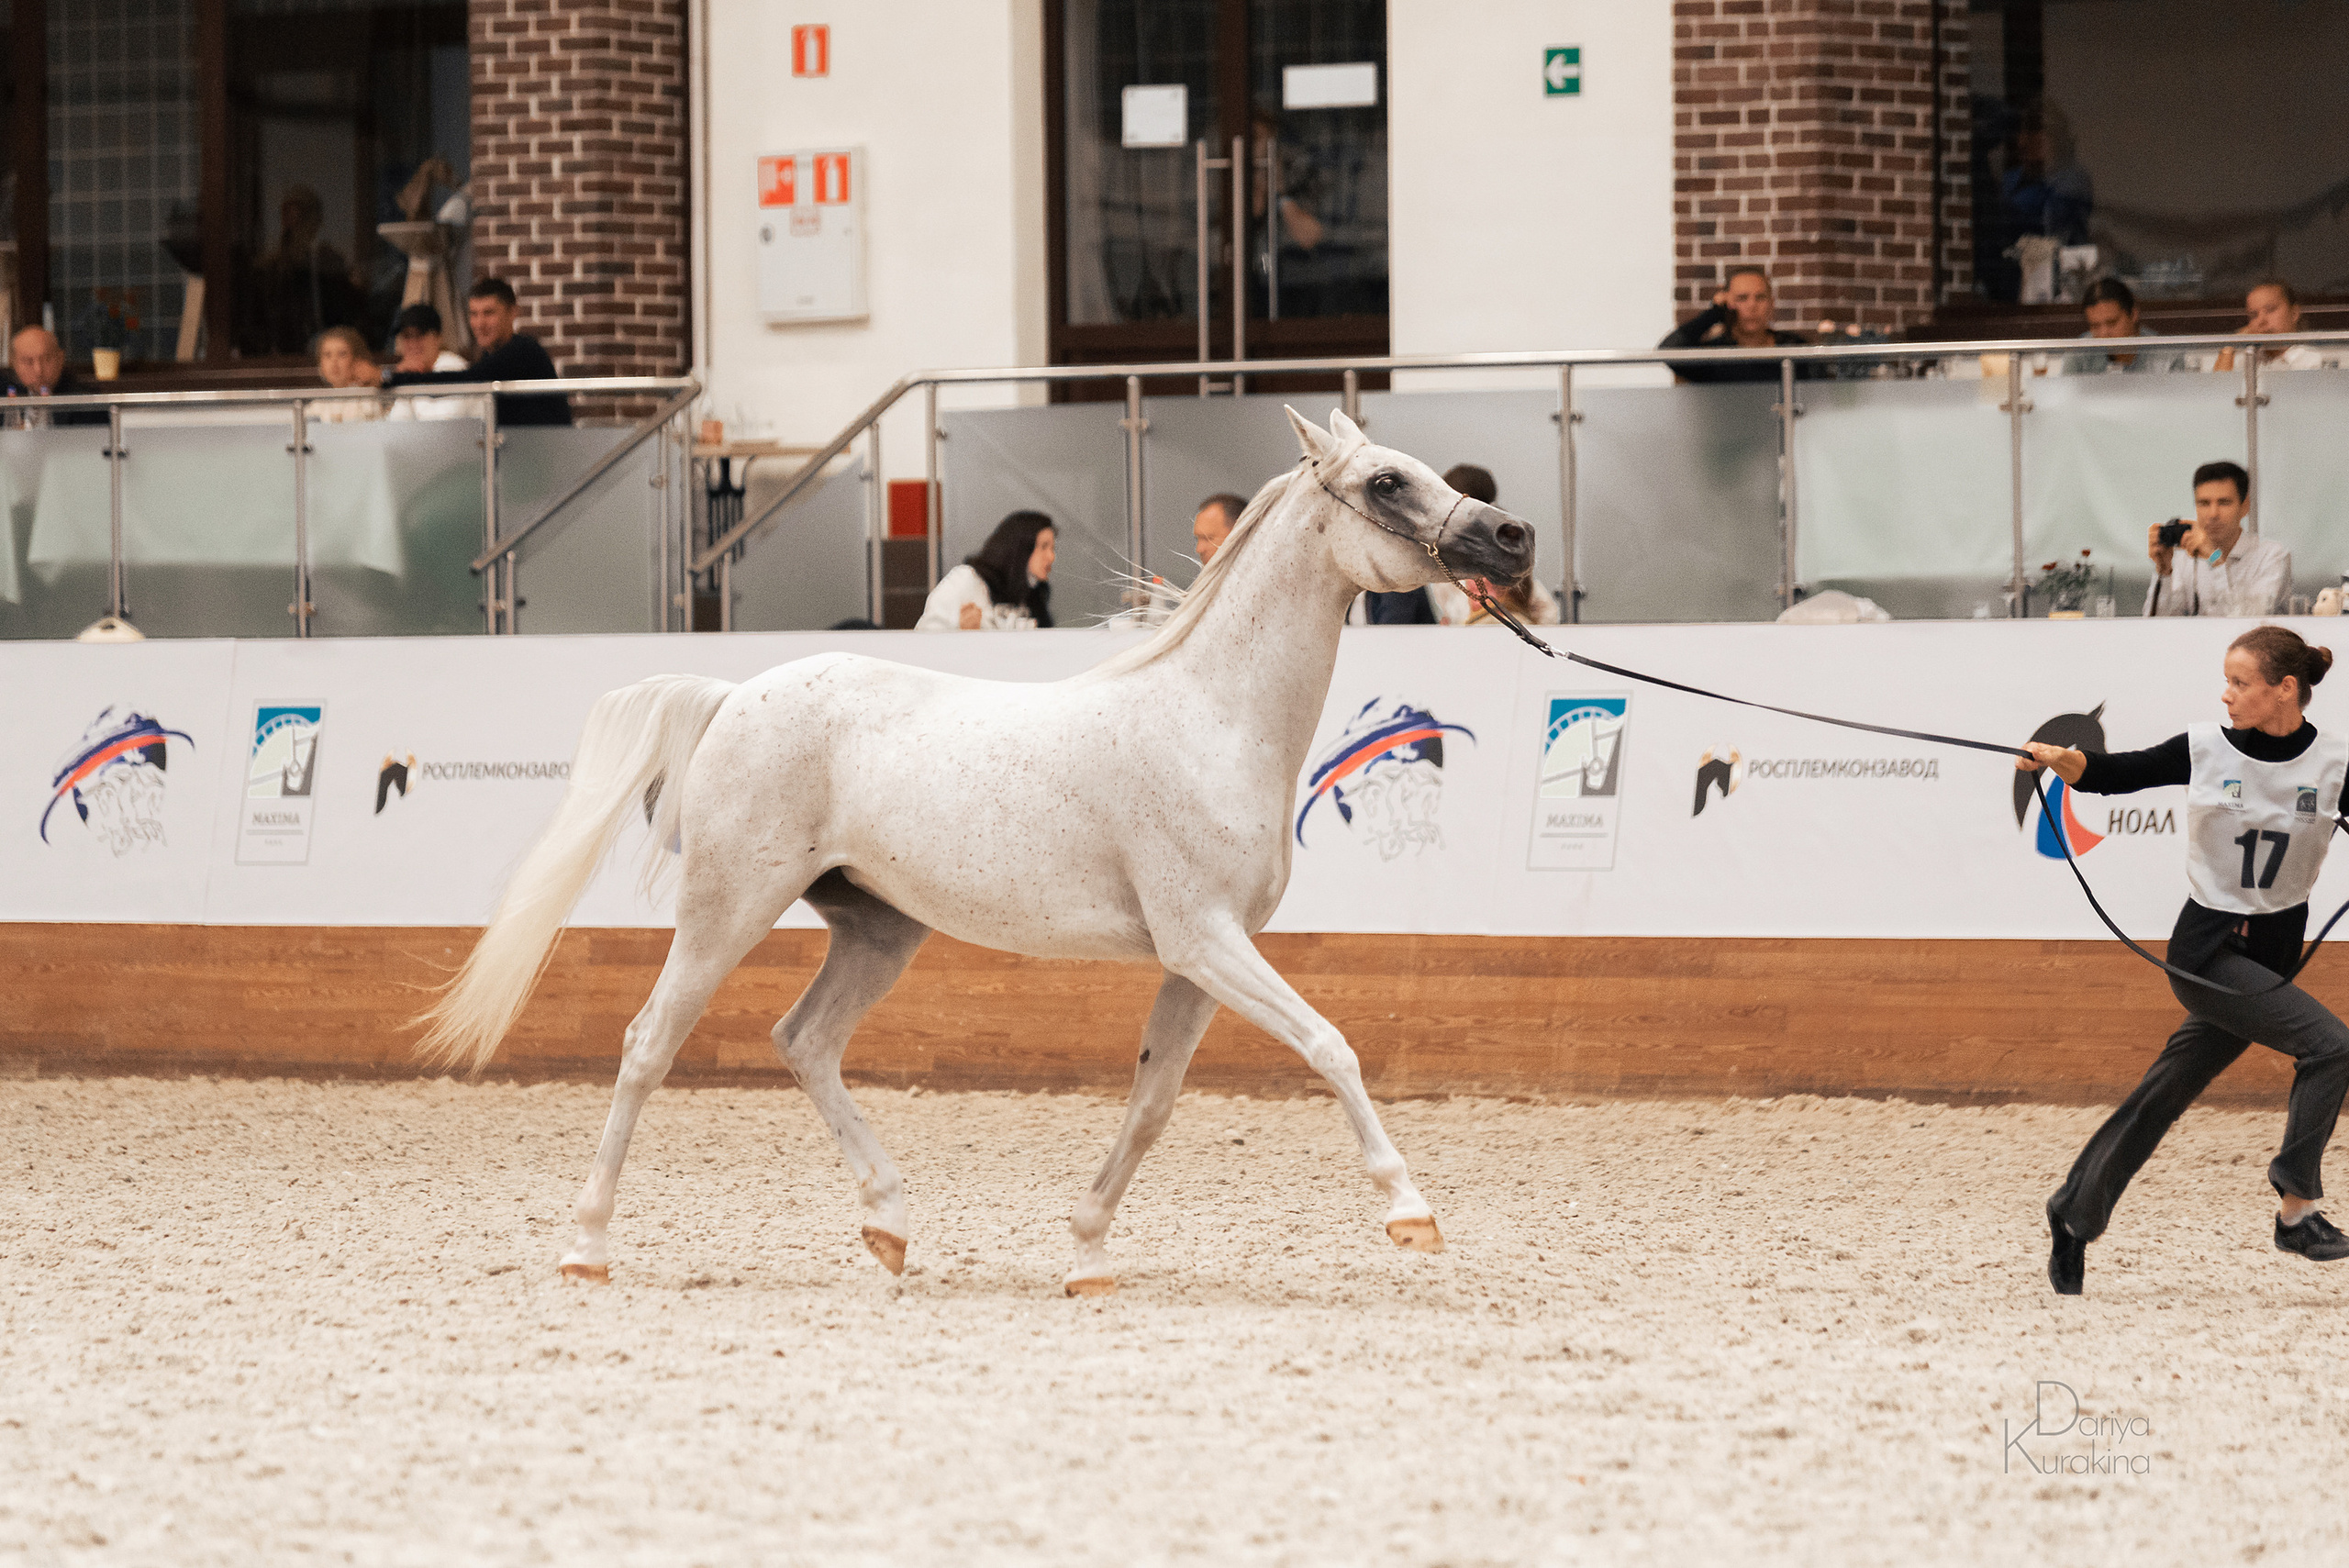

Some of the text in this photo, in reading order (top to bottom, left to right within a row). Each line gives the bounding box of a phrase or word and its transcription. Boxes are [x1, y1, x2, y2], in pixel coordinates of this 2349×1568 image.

[422, 761, 570, 780] РОСПЛЕМКОНЗАВО
[1747, 758, 1940, 780] РОСПЛЕМКОНЗАВОД
[251, 811, 301, 825] MAXIMA
[1545, 813, 1605, 828] MAXIMA
[2108, 807, 2176, 834] НОАЛ
[2233, 828, 2290, 889] 17
